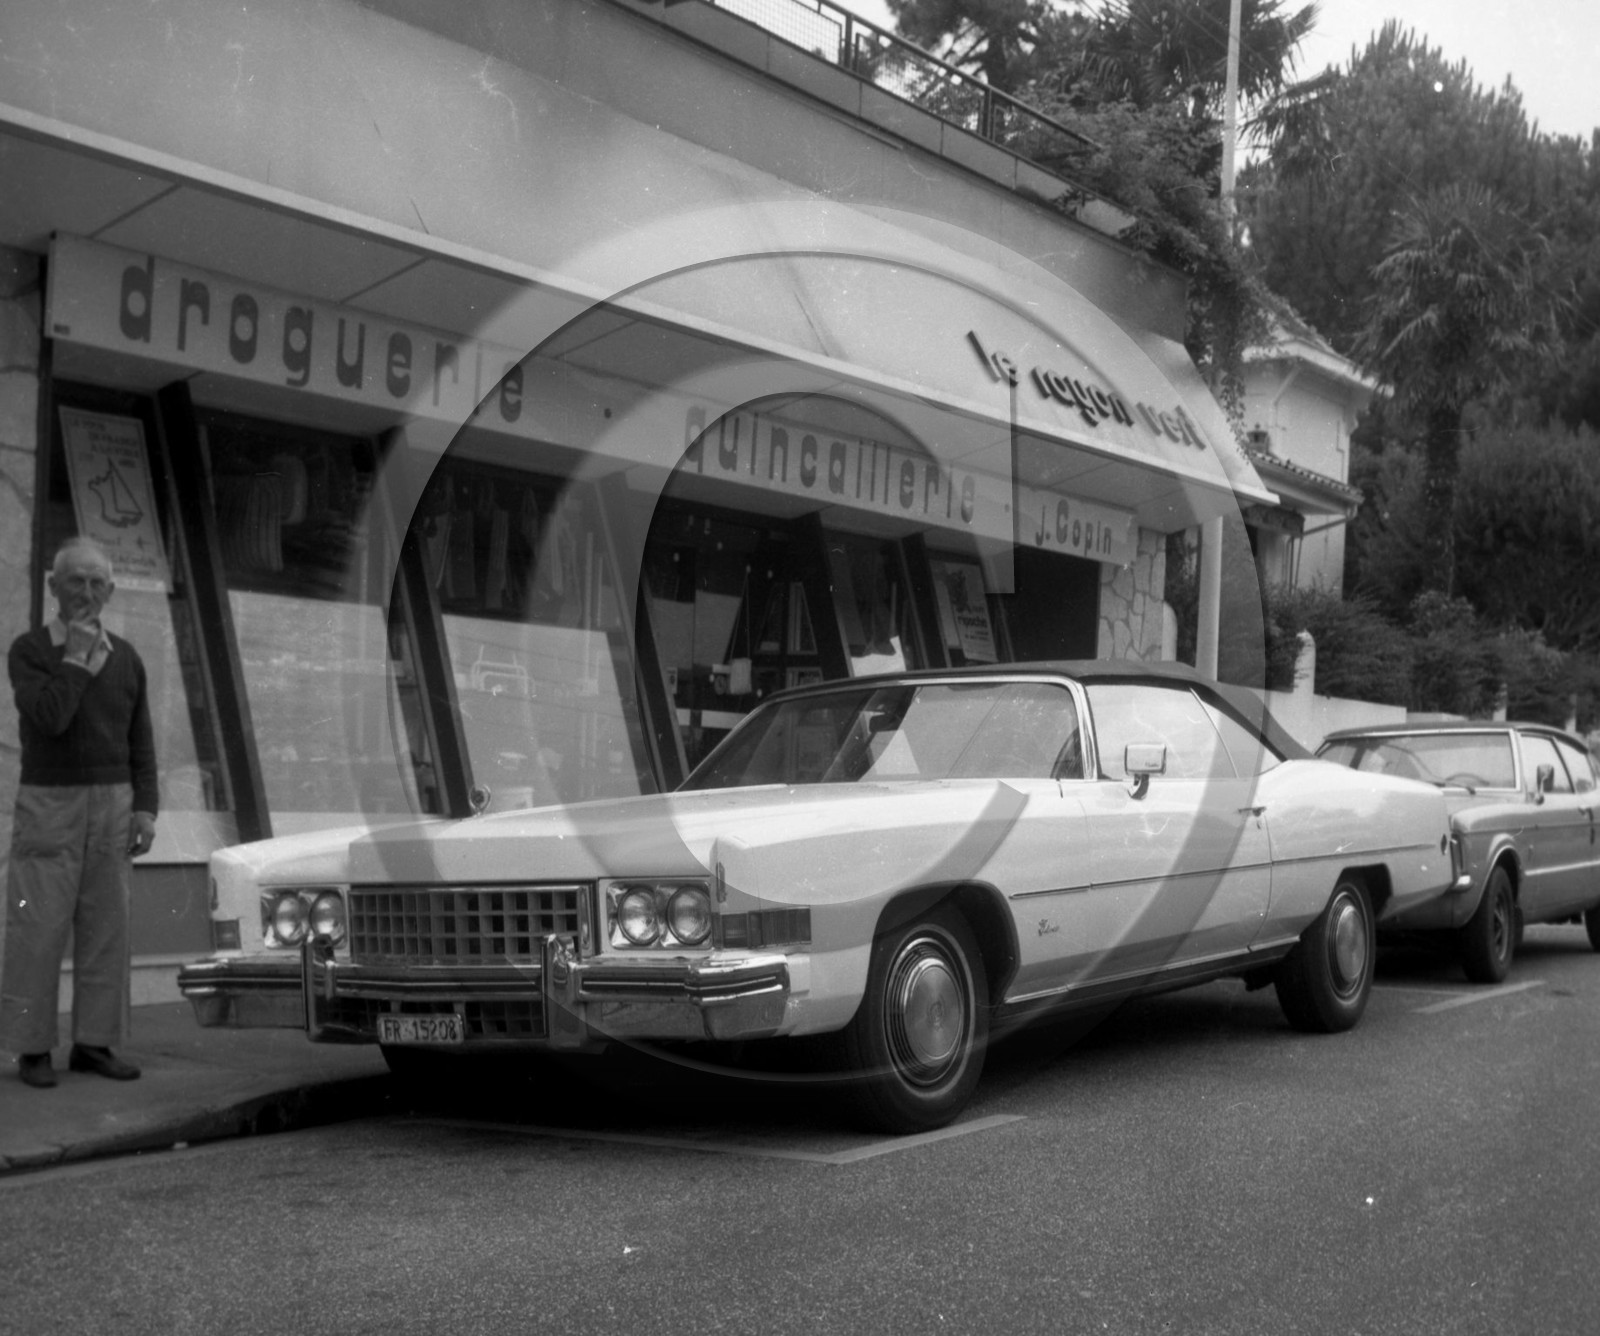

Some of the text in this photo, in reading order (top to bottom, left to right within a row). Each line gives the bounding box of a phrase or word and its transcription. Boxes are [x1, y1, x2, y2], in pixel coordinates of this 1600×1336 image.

[119, 255, 524, 424] droguerie
[965, 330, 1207, 451] le rayon vert
[684, 405, 977, 525] quincaillerie
